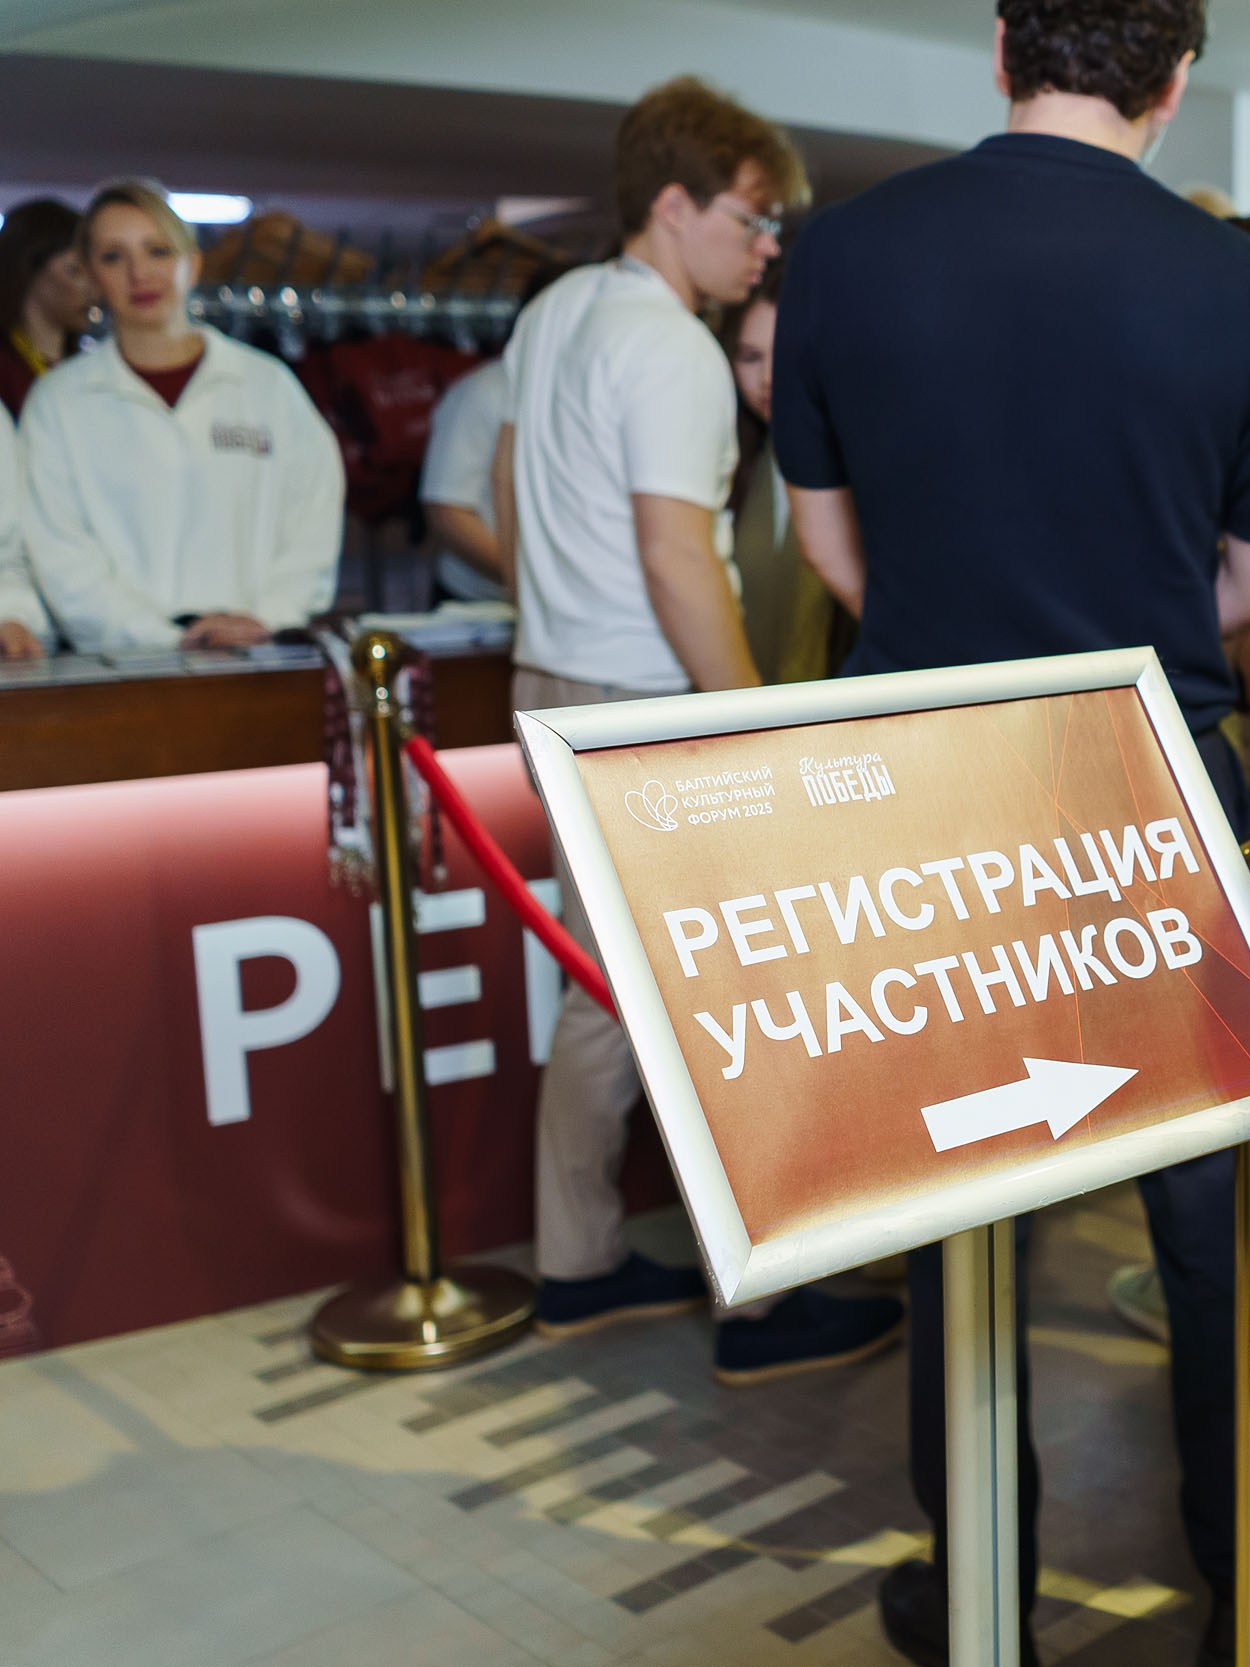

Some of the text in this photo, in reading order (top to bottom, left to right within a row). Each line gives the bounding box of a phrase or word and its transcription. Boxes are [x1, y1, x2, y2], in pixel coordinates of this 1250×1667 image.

[674, 765, 773, 793] БАЛТИЙСКИЙ
[798, 752, 882, 778] Культура
[681, 782, 776, 809] КУЛЬТУРНЫЙ
[801, 764, 896, 807] ПОБЕДЫ
[687, 801, 774, 826] ФОРУМ 2025
[662, 817, 1200, 978] РЕГИСТРАЦИЯ
[692, 907, 1203, 1080] УЧАСТНИКОВ
